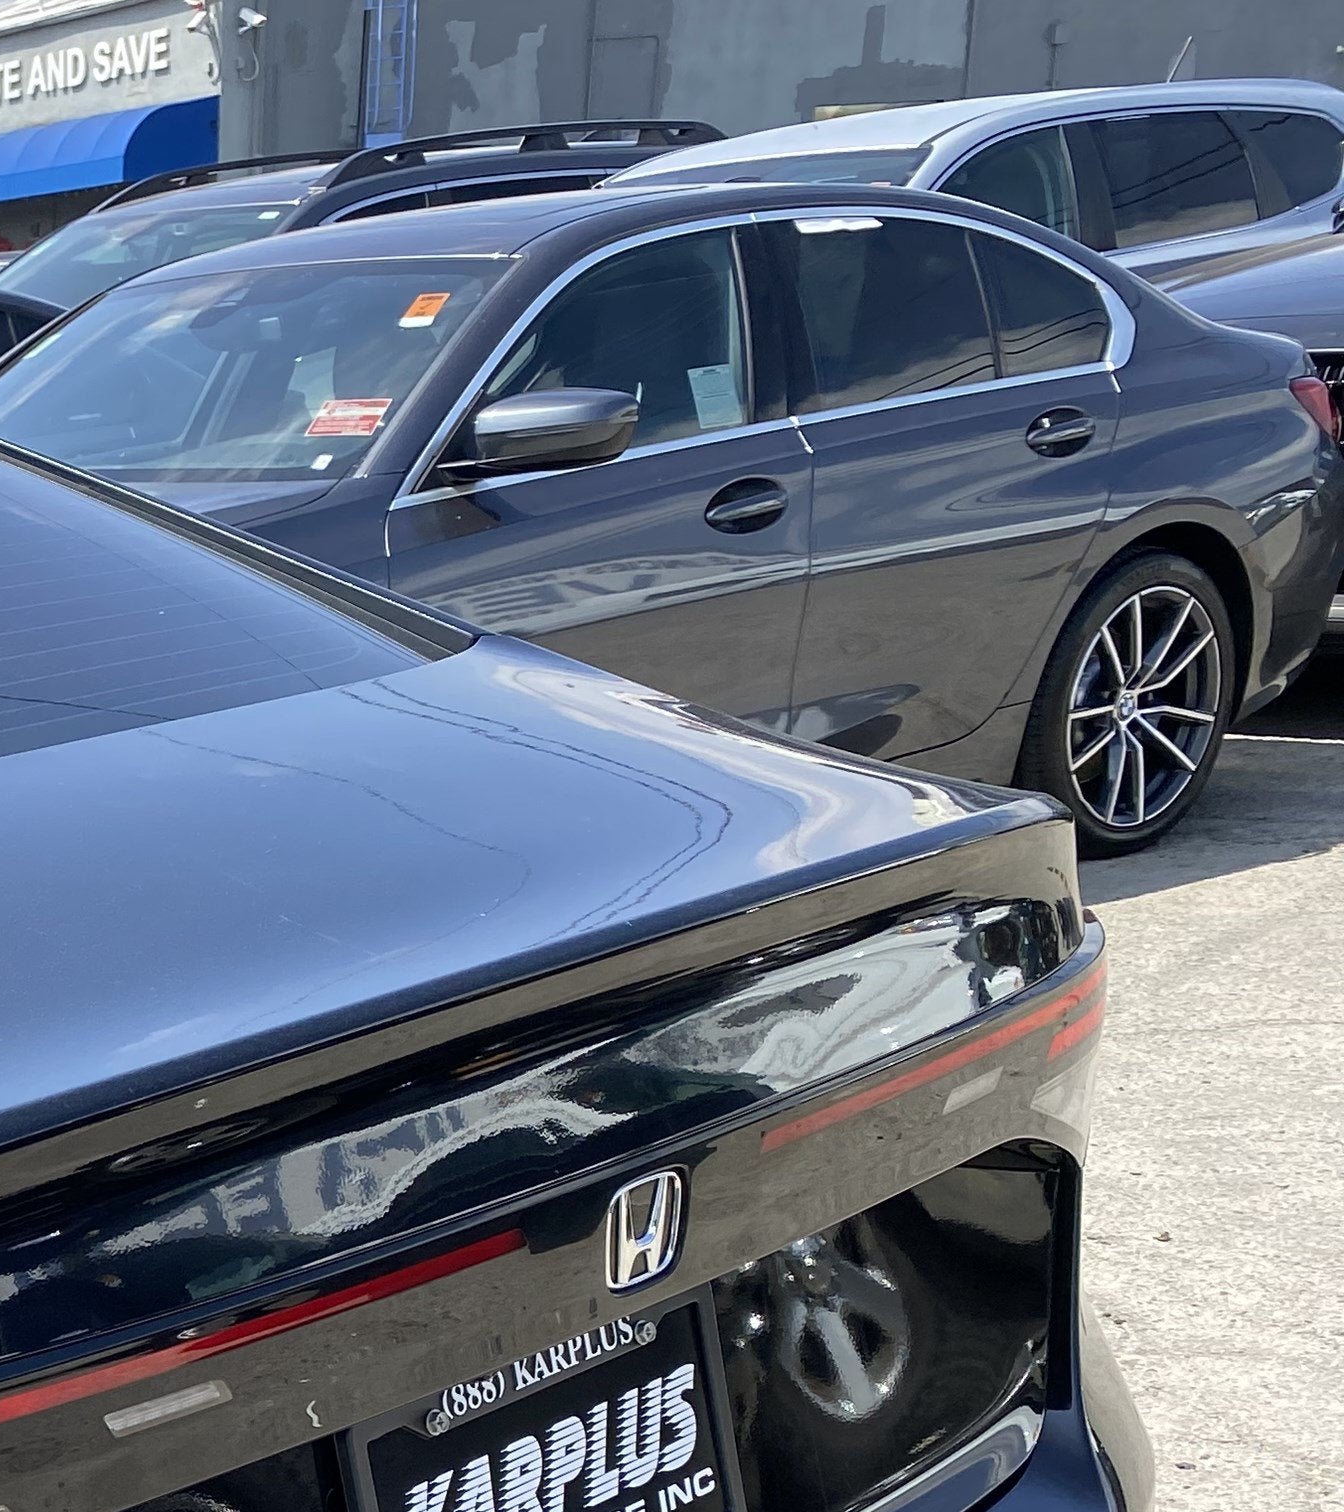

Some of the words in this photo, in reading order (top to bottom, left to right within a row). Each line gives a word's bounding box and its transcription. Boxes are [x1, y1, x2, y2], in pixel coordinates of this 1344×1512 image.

[27, 46, 85, 96] AND
[92, 28, 170, 82] SAVE
[513, 1316, 635, 1391] KARPLUS
